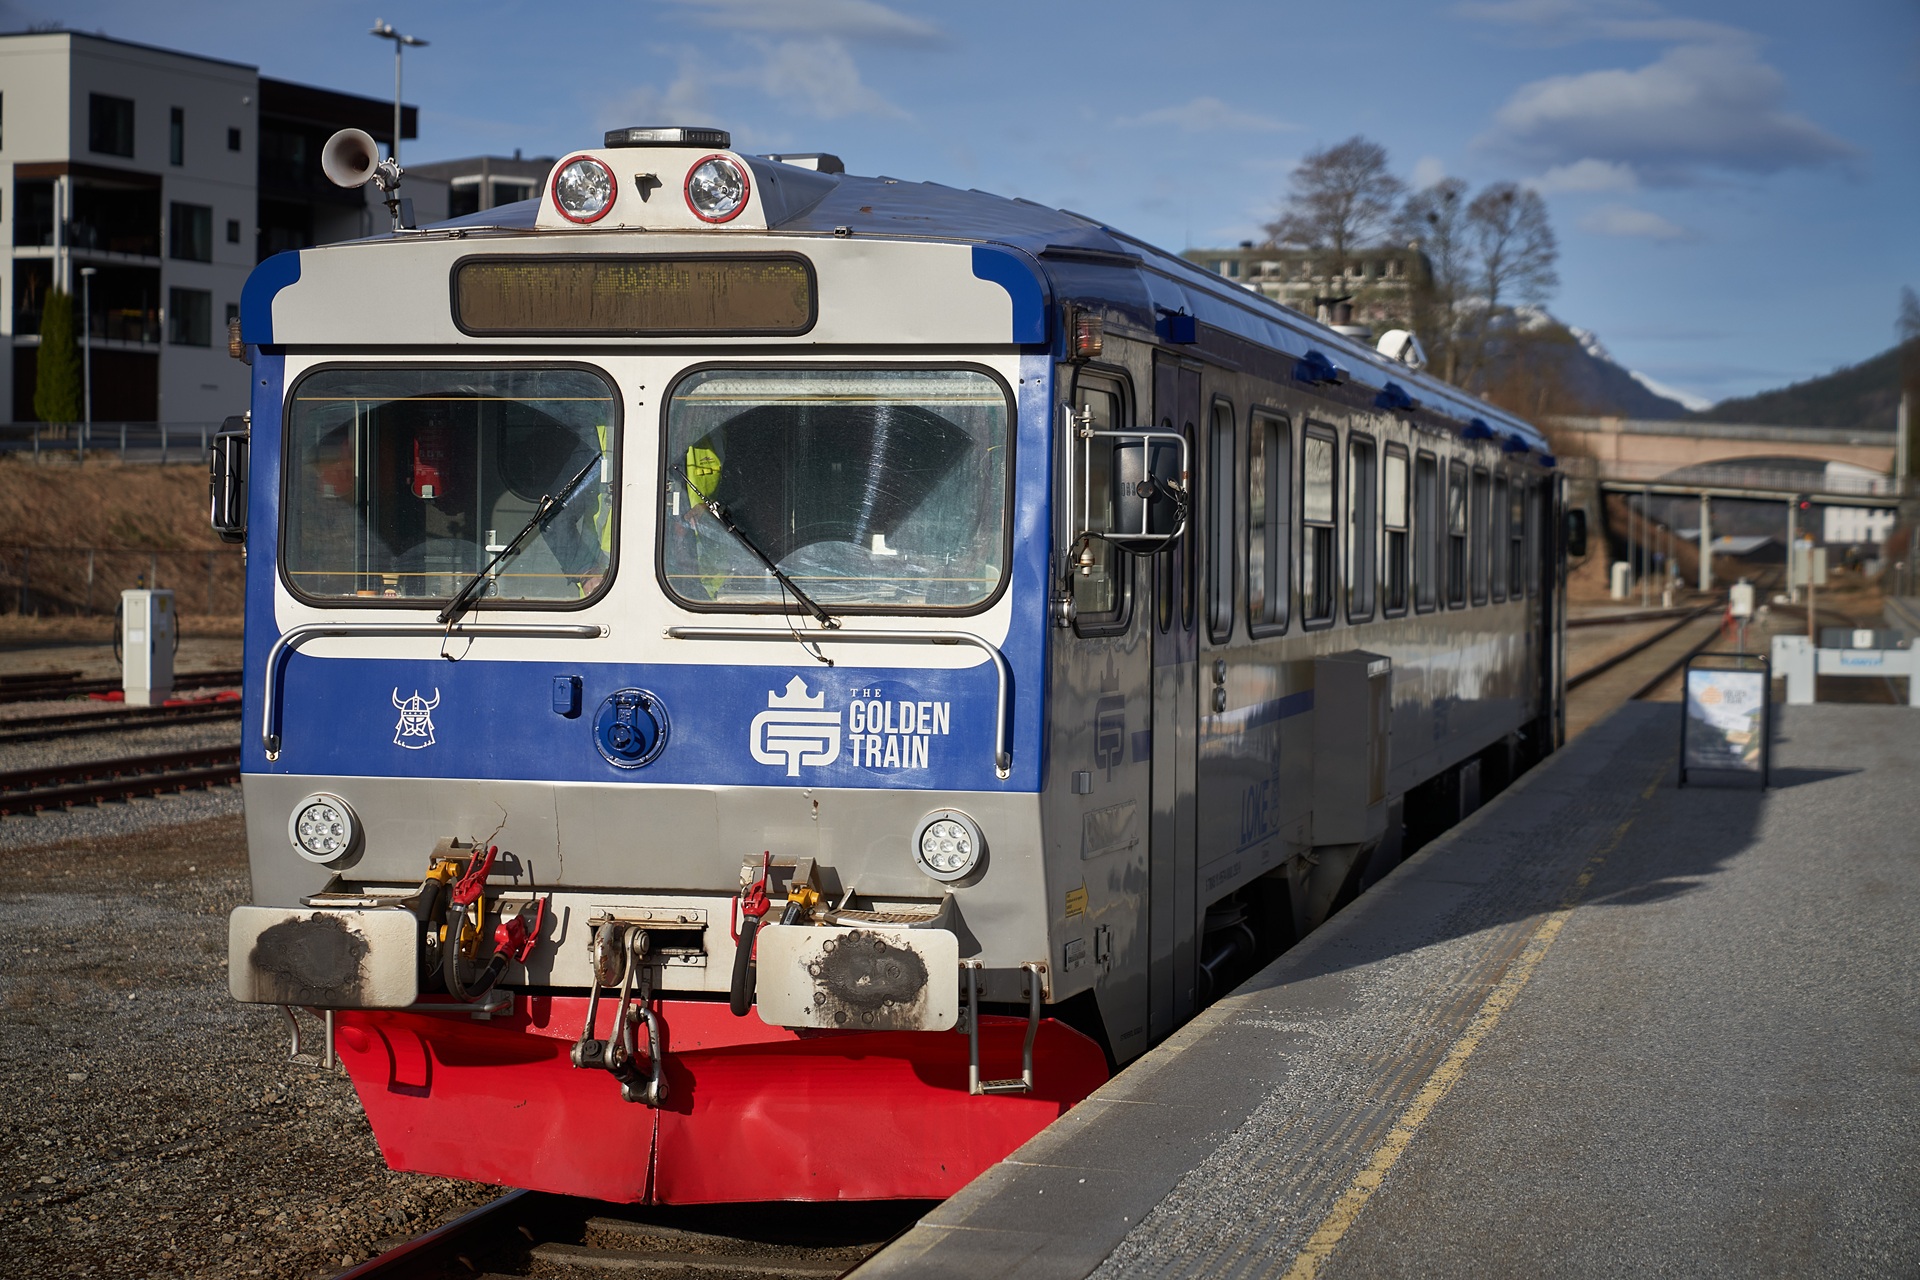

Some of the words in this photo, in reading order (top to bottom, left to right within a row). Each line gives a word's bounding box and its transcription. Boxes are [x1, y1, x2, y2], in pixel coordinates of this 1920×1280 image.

[850, 688, 882, 698] THE
[850, 700, 950, 735] GOLDEN
[849, 735, 929, 769] TRAIN
[1240, 780, 1270, 845] LOKE
